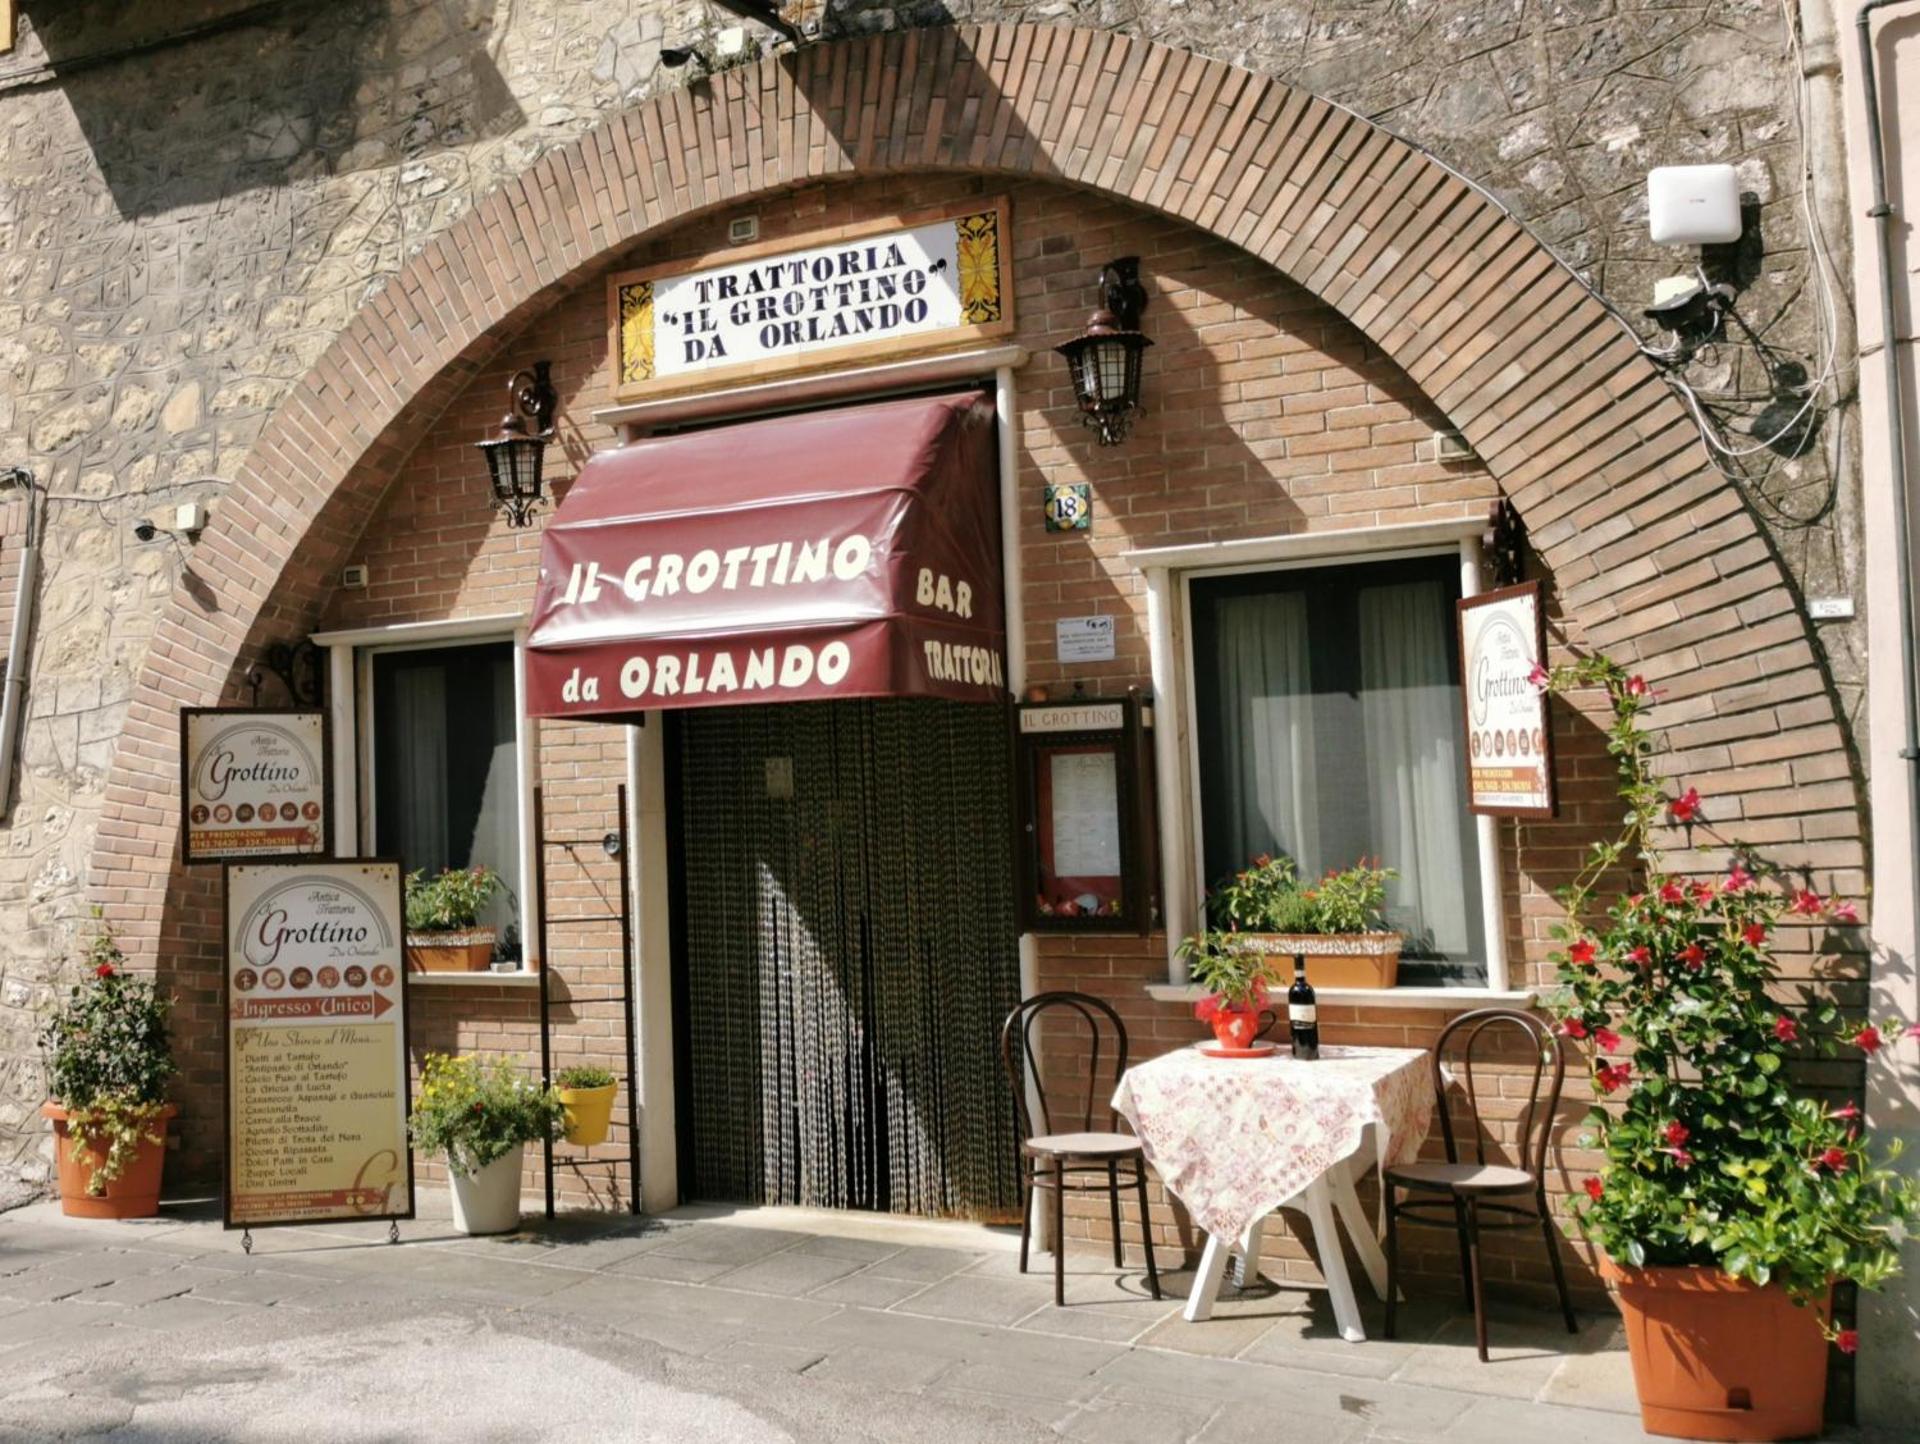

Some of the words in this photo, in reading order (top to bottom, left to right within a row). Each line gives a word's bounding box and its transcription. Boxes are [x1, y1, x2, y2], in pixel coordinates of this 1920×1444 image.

[695, 242, 906, 305] TRATTORIA
[684, 334, 727, 363] DA
[759, 297, 928, 349] ORLANDO
[1056, 497, 1077, 518] 18
[562, 562, 602, 605] IL
[623, 534, 871, 602] GROTTINO
[916, 567, 972, 619] BAR
[562, 667, 599, 703] da
[620, 641, 850, 698] ORLANDO
[1024, 713, 1036, 727] IL
[1041, 709, 1119, 726] GROTTINO
[199, 751, 299, 801] Grottino
[244, 908, 367, 968] Grottino
[243, 998, 312, 1021] Ingresso
[316, 995, 371, 1016] Unico
